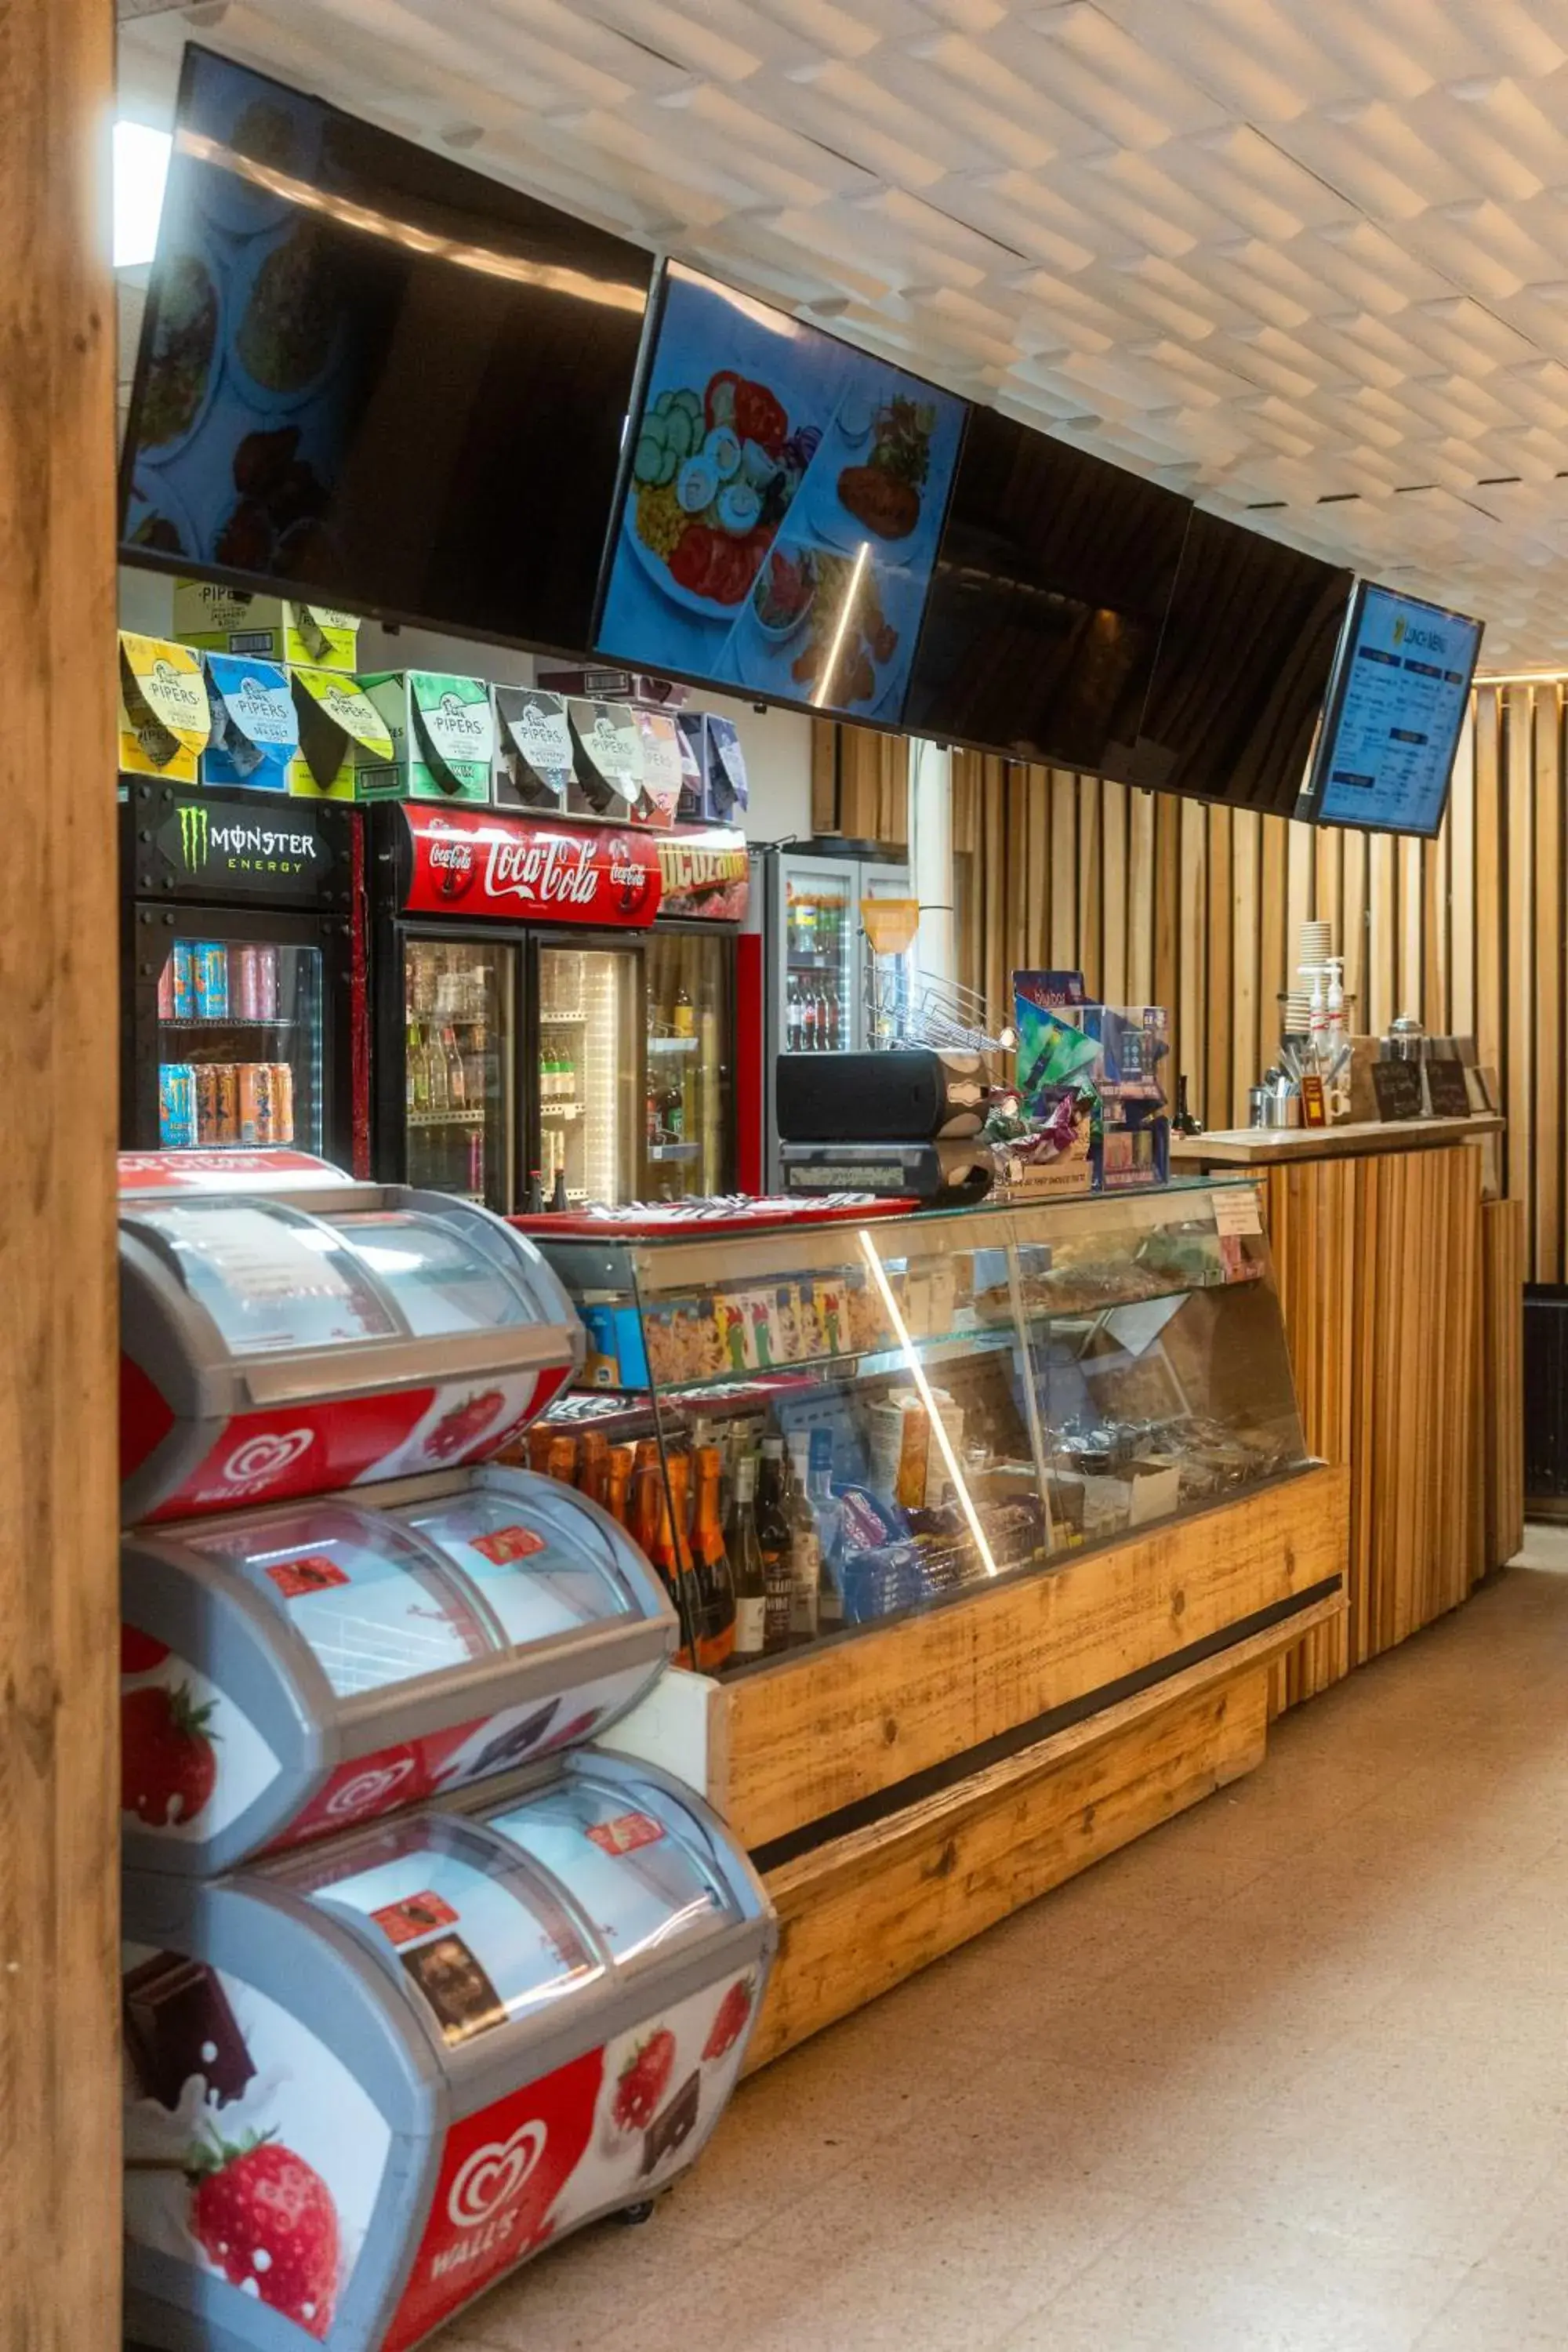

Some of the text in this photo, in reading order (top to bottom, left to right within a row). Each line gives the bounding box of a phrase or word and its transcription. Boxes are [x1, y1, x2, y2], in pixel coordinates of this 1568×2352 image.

[151, 682, 198, 705] PIPERS
[238, 700, 288, 718] PIPERS
[435, 717, 483, 735] PIPERS
[210, 825, 317, 858] MONSTER
[228, 858, 303, 873] ENERGY
[485, 839, 599, 903] Coca-Cola
